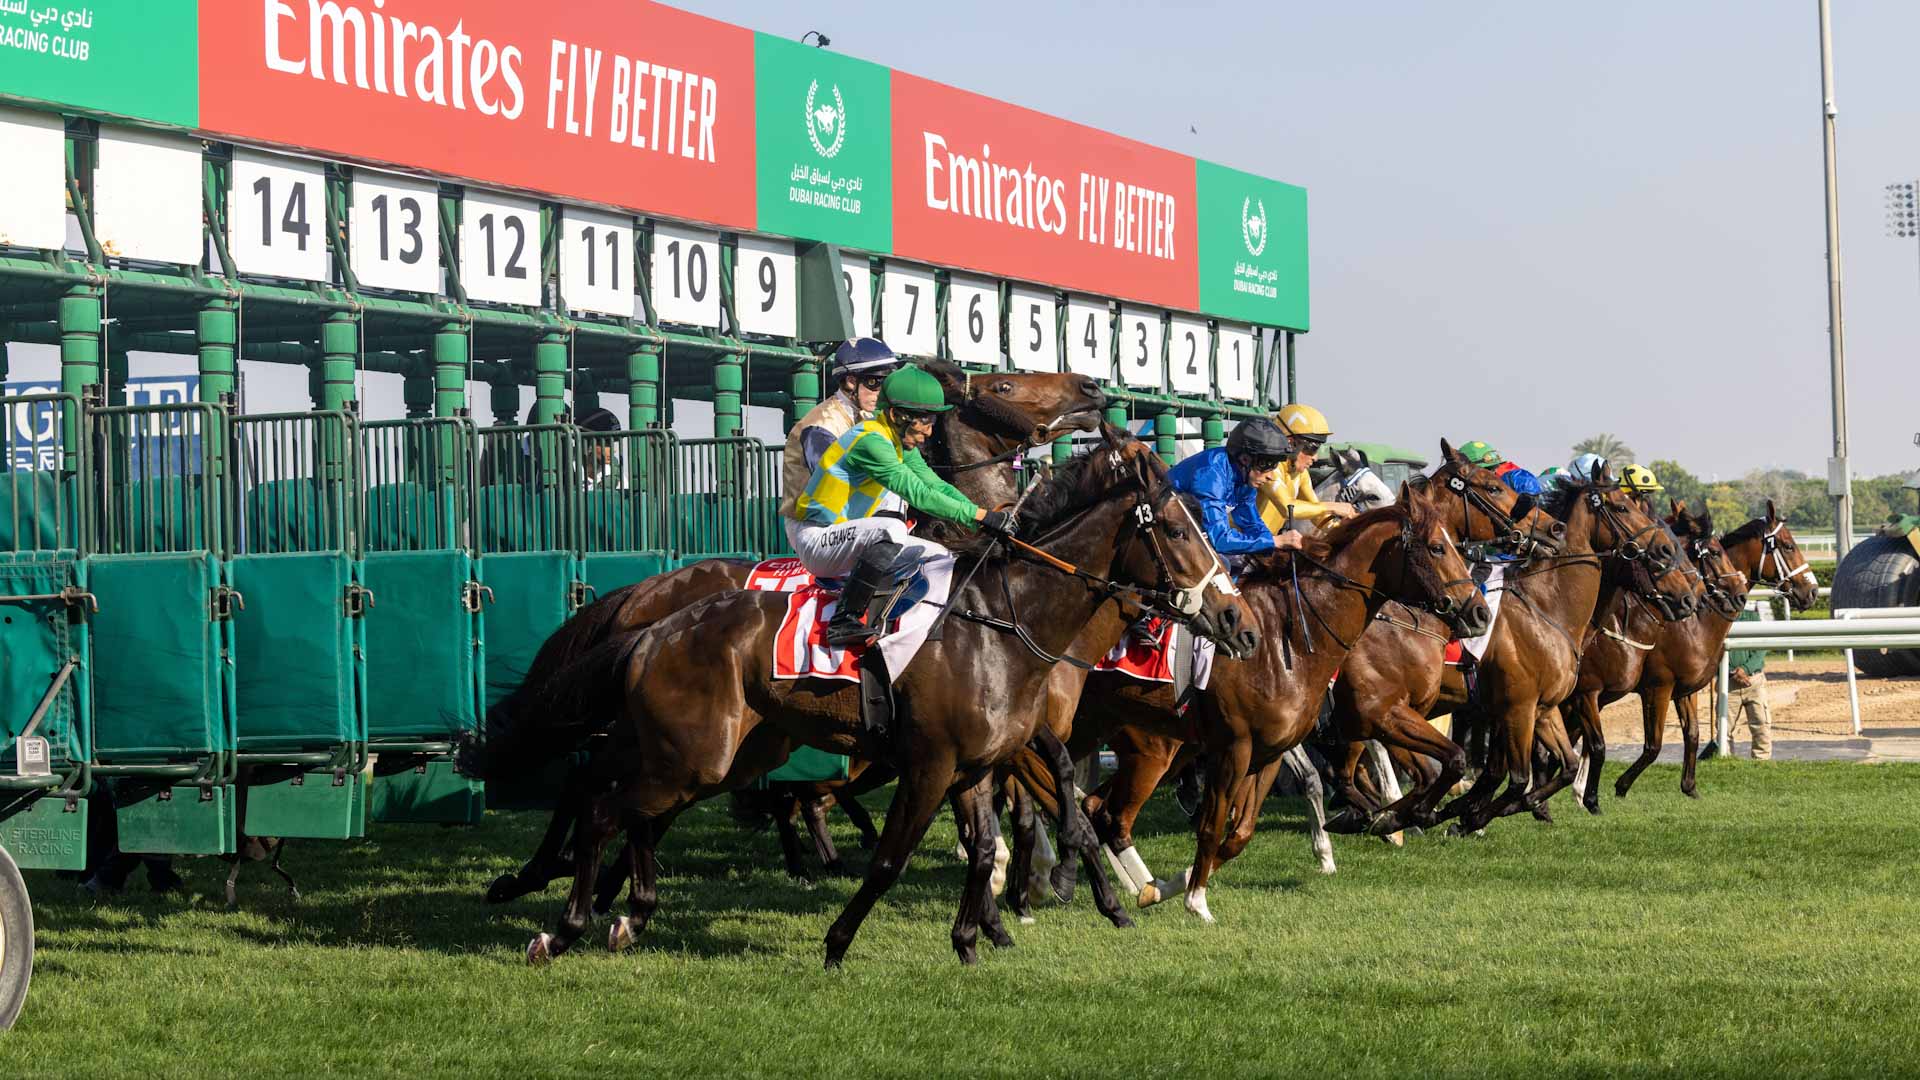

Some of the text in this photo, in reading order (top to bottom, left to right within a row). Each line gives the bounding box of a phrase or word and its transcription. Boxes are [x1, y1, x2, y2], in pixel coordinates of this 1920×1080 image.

[30, 7, 58, 28] دبي
[61, 7, 93, 32] نادي
[52, 35, 90, 61] CLUB
[264, 0, 525, 121] Emirates
[546, 39, 717, 164] FLY BETTER
[789, 186, 861, 214] DUBAI RACING CLUB
[790, 162, 863, 195] نادي دبي لسباق الخيل
[923, 131, 1067, 235] Emirates
[253, 176, 311, 252] 14
[371, 194, 424, 265] 13
[1078, 172, 1176, 261] FLY BETTER
[478, 213, 527, 280] 12
[581, 225, 619, 291] 11
[667, 240, 707, 302] 10
[758, 256, 777, 313] 9
[904, 284, 920, 336] 7
[968, 293, 984, 344] 6
[1029, 304, 1042, 352] 5
[1083, 312, 1098, 359] 4
[1136, 322, 1149, 367] 3
[1185, 331, 1198, 376] 2
[1232, 339, 1241, 381] 1
[1450, 477, 1465, 491] 8
[828, 525, 857, 546] CHAVEZ
[1135, 503, 1154, 524] 13
[1766, 537, 1775, 549] 7
[18, 841, 75, 856] RACING
